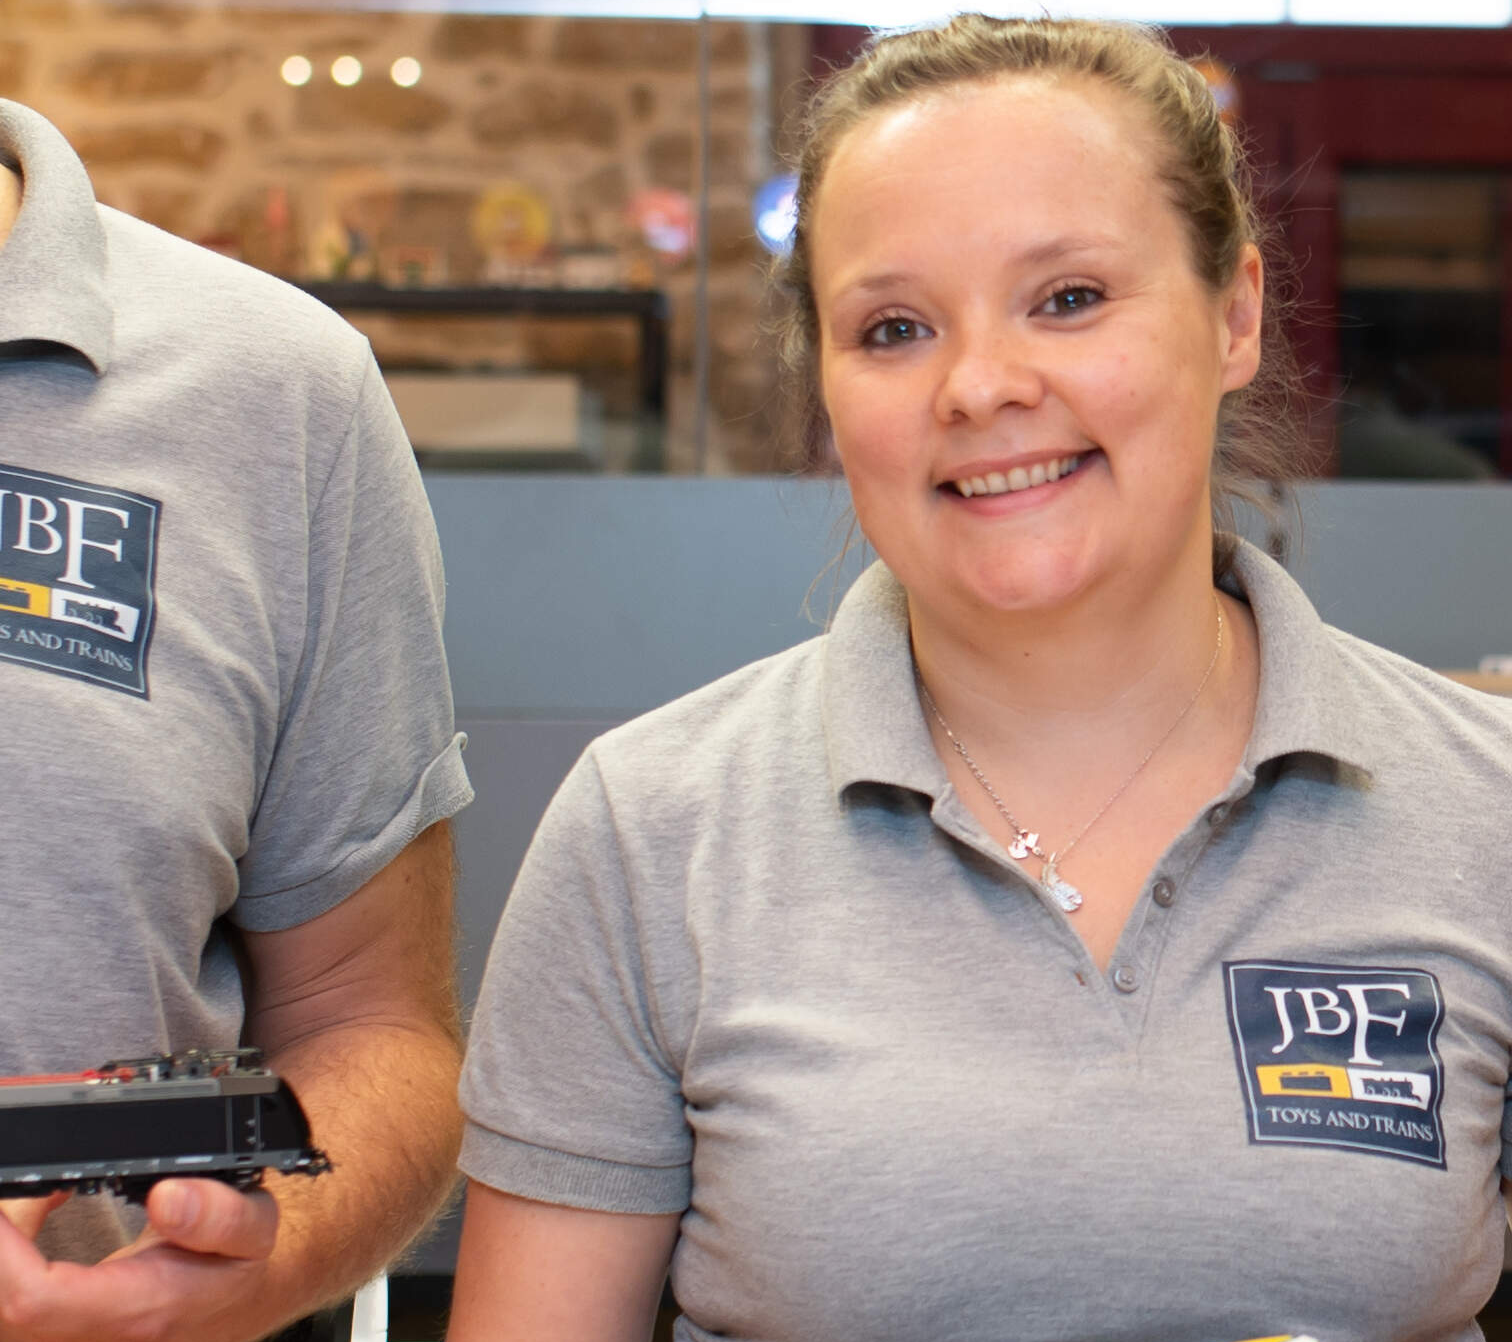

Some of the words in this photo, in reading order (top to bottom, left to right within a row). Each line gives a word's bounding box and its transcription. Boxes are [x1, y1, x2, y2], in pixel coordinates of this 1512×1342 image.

[15, 629, 63, 651] AND
[65, 638, 134, 672] TRAINS
[1264, 983, 1411, 1066] JBF
[1266, 1107, 1321, 1125] TOYS
[1326, 1112, 1370, 1130] AND
[1371, 1115, 1434, 1142] TRAINS
